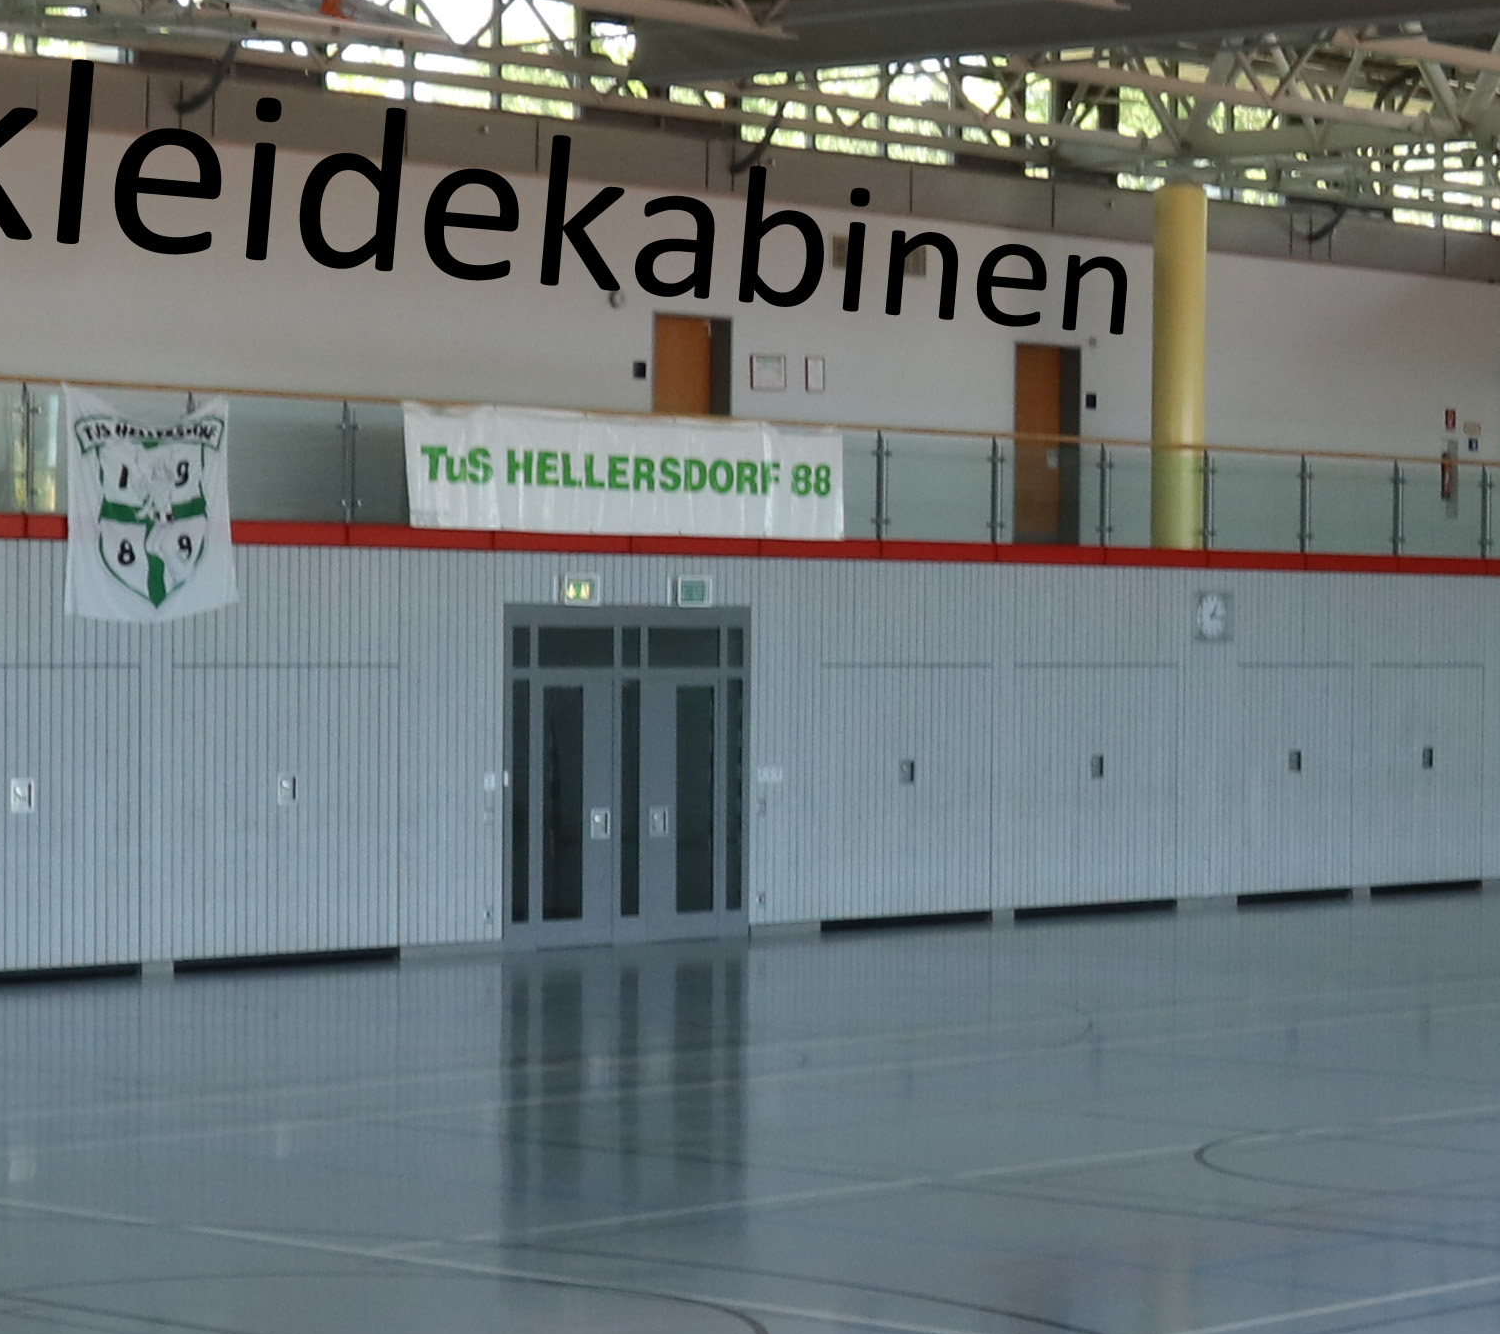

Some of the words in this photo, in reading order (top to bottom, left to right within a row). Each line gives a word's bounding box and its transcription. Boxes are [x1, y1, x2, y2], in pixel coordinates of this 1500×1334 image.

[175, 460, 190, 486] 9
[421, 444, 494, 485] TuS
[506, 448, 781, 497] HELLERSDORF
[790, 462, 832, 497] 88
[118, 538, 135, 565] 8
[178, 535, 192, 560] 9
